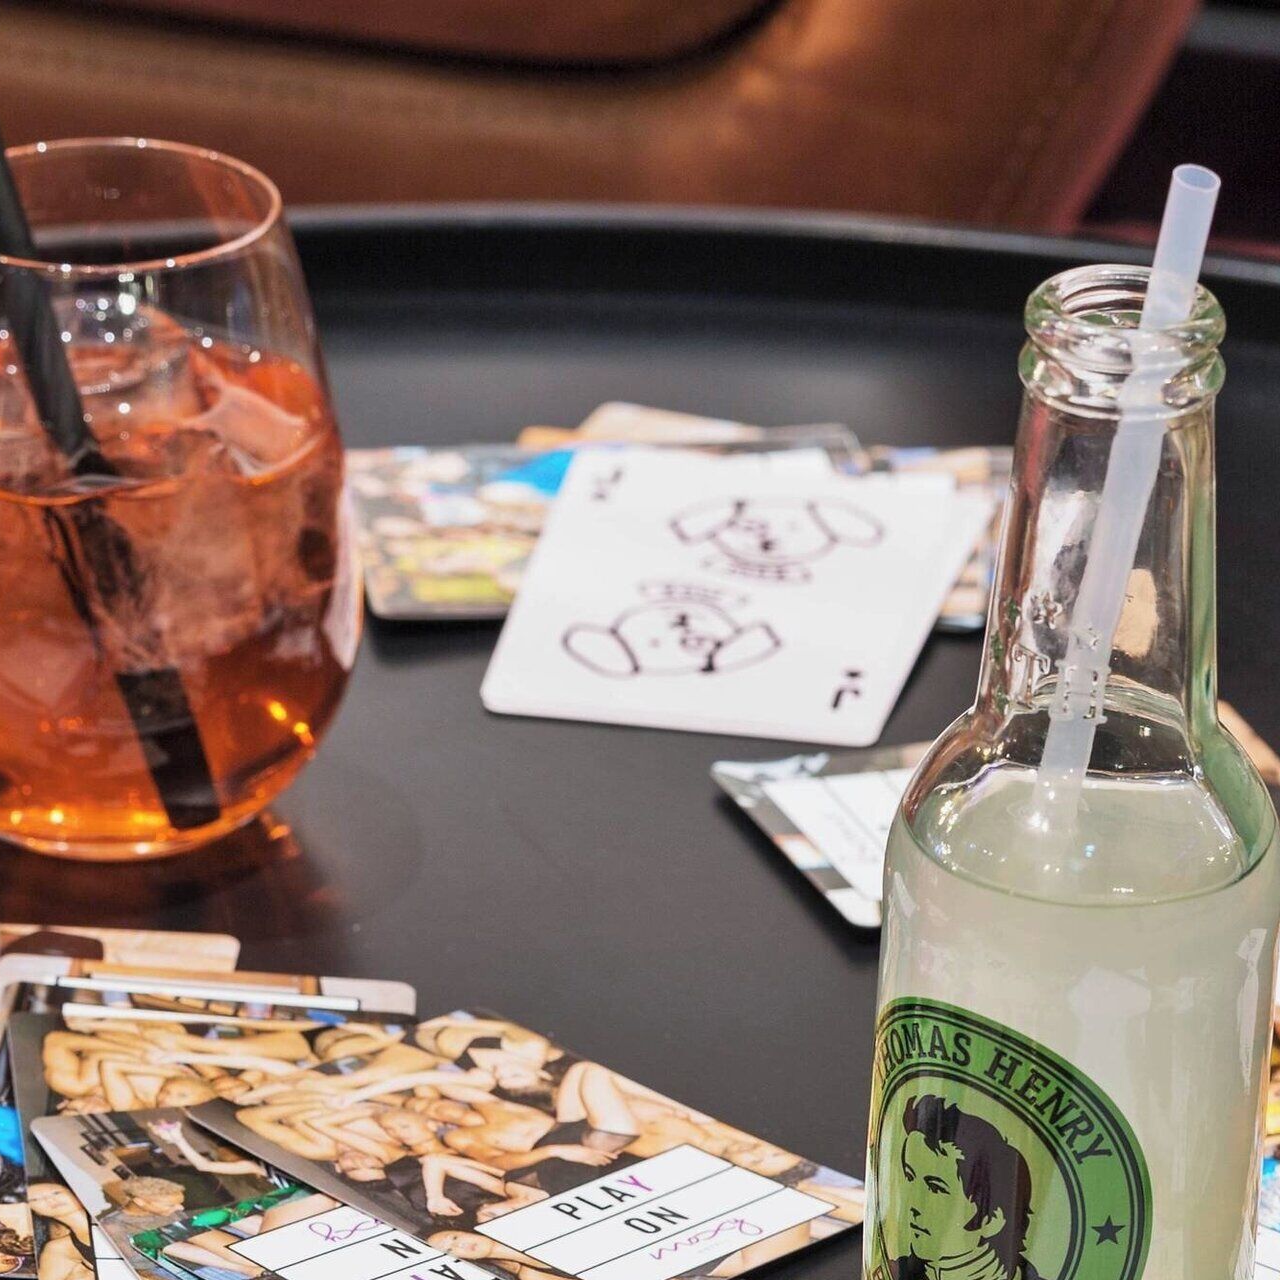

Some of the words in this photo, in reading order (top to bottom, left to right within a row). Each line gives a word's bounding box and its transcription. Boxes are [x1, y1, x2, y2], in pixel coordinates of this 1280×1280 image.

[983, 1047, 1112, 1165] HENRY
[552, 1173, 655, 1221] PLAY
[624, 1206, 689, 1235] ON
